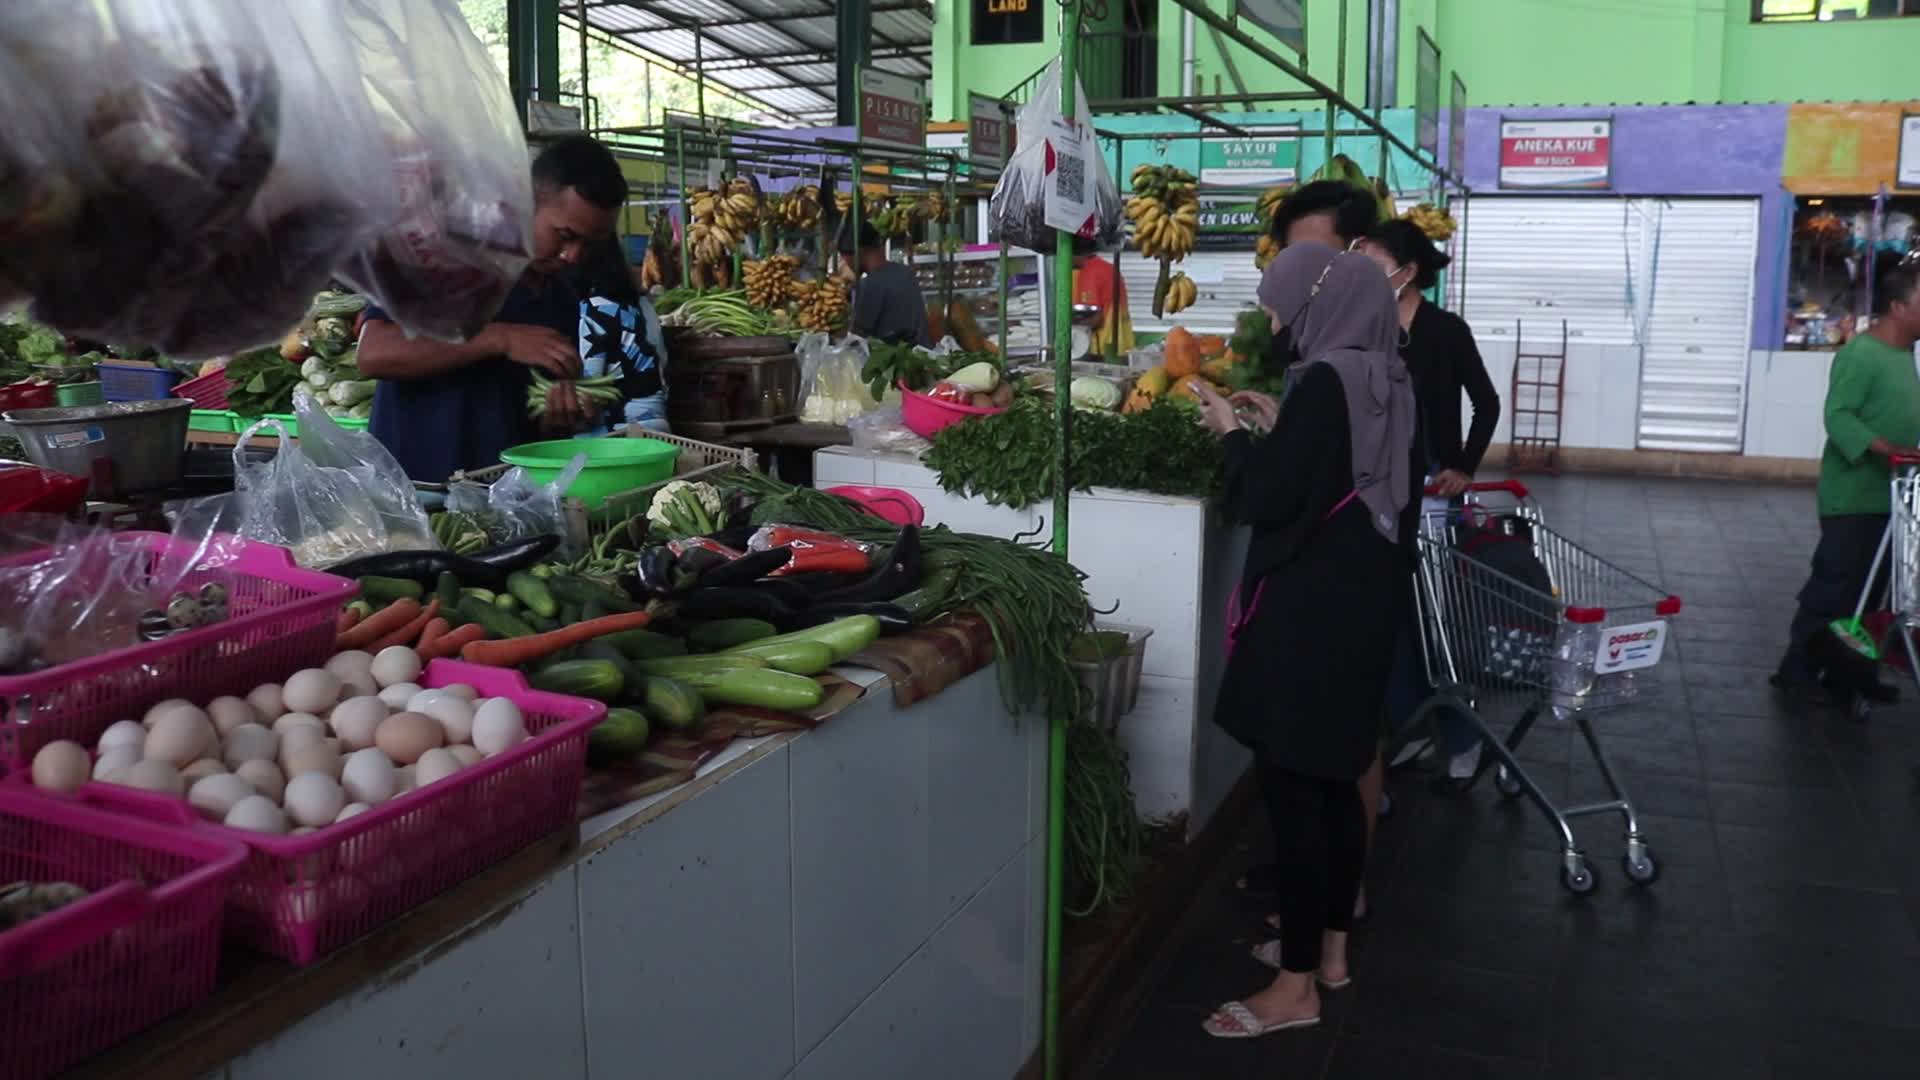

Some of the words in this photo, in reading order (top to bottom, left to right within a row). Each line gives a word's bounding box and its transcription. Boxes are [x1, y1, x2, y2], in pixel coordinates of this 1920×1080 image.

[987, 0, 1027, 12] LAND
[866, 97, 919, 122] PISANG
[1223, 142, 1277, 154] SAYUR
[1514, 139, 1564, 152] ANEKA
[1567, 139, 1596, 152] KUE
